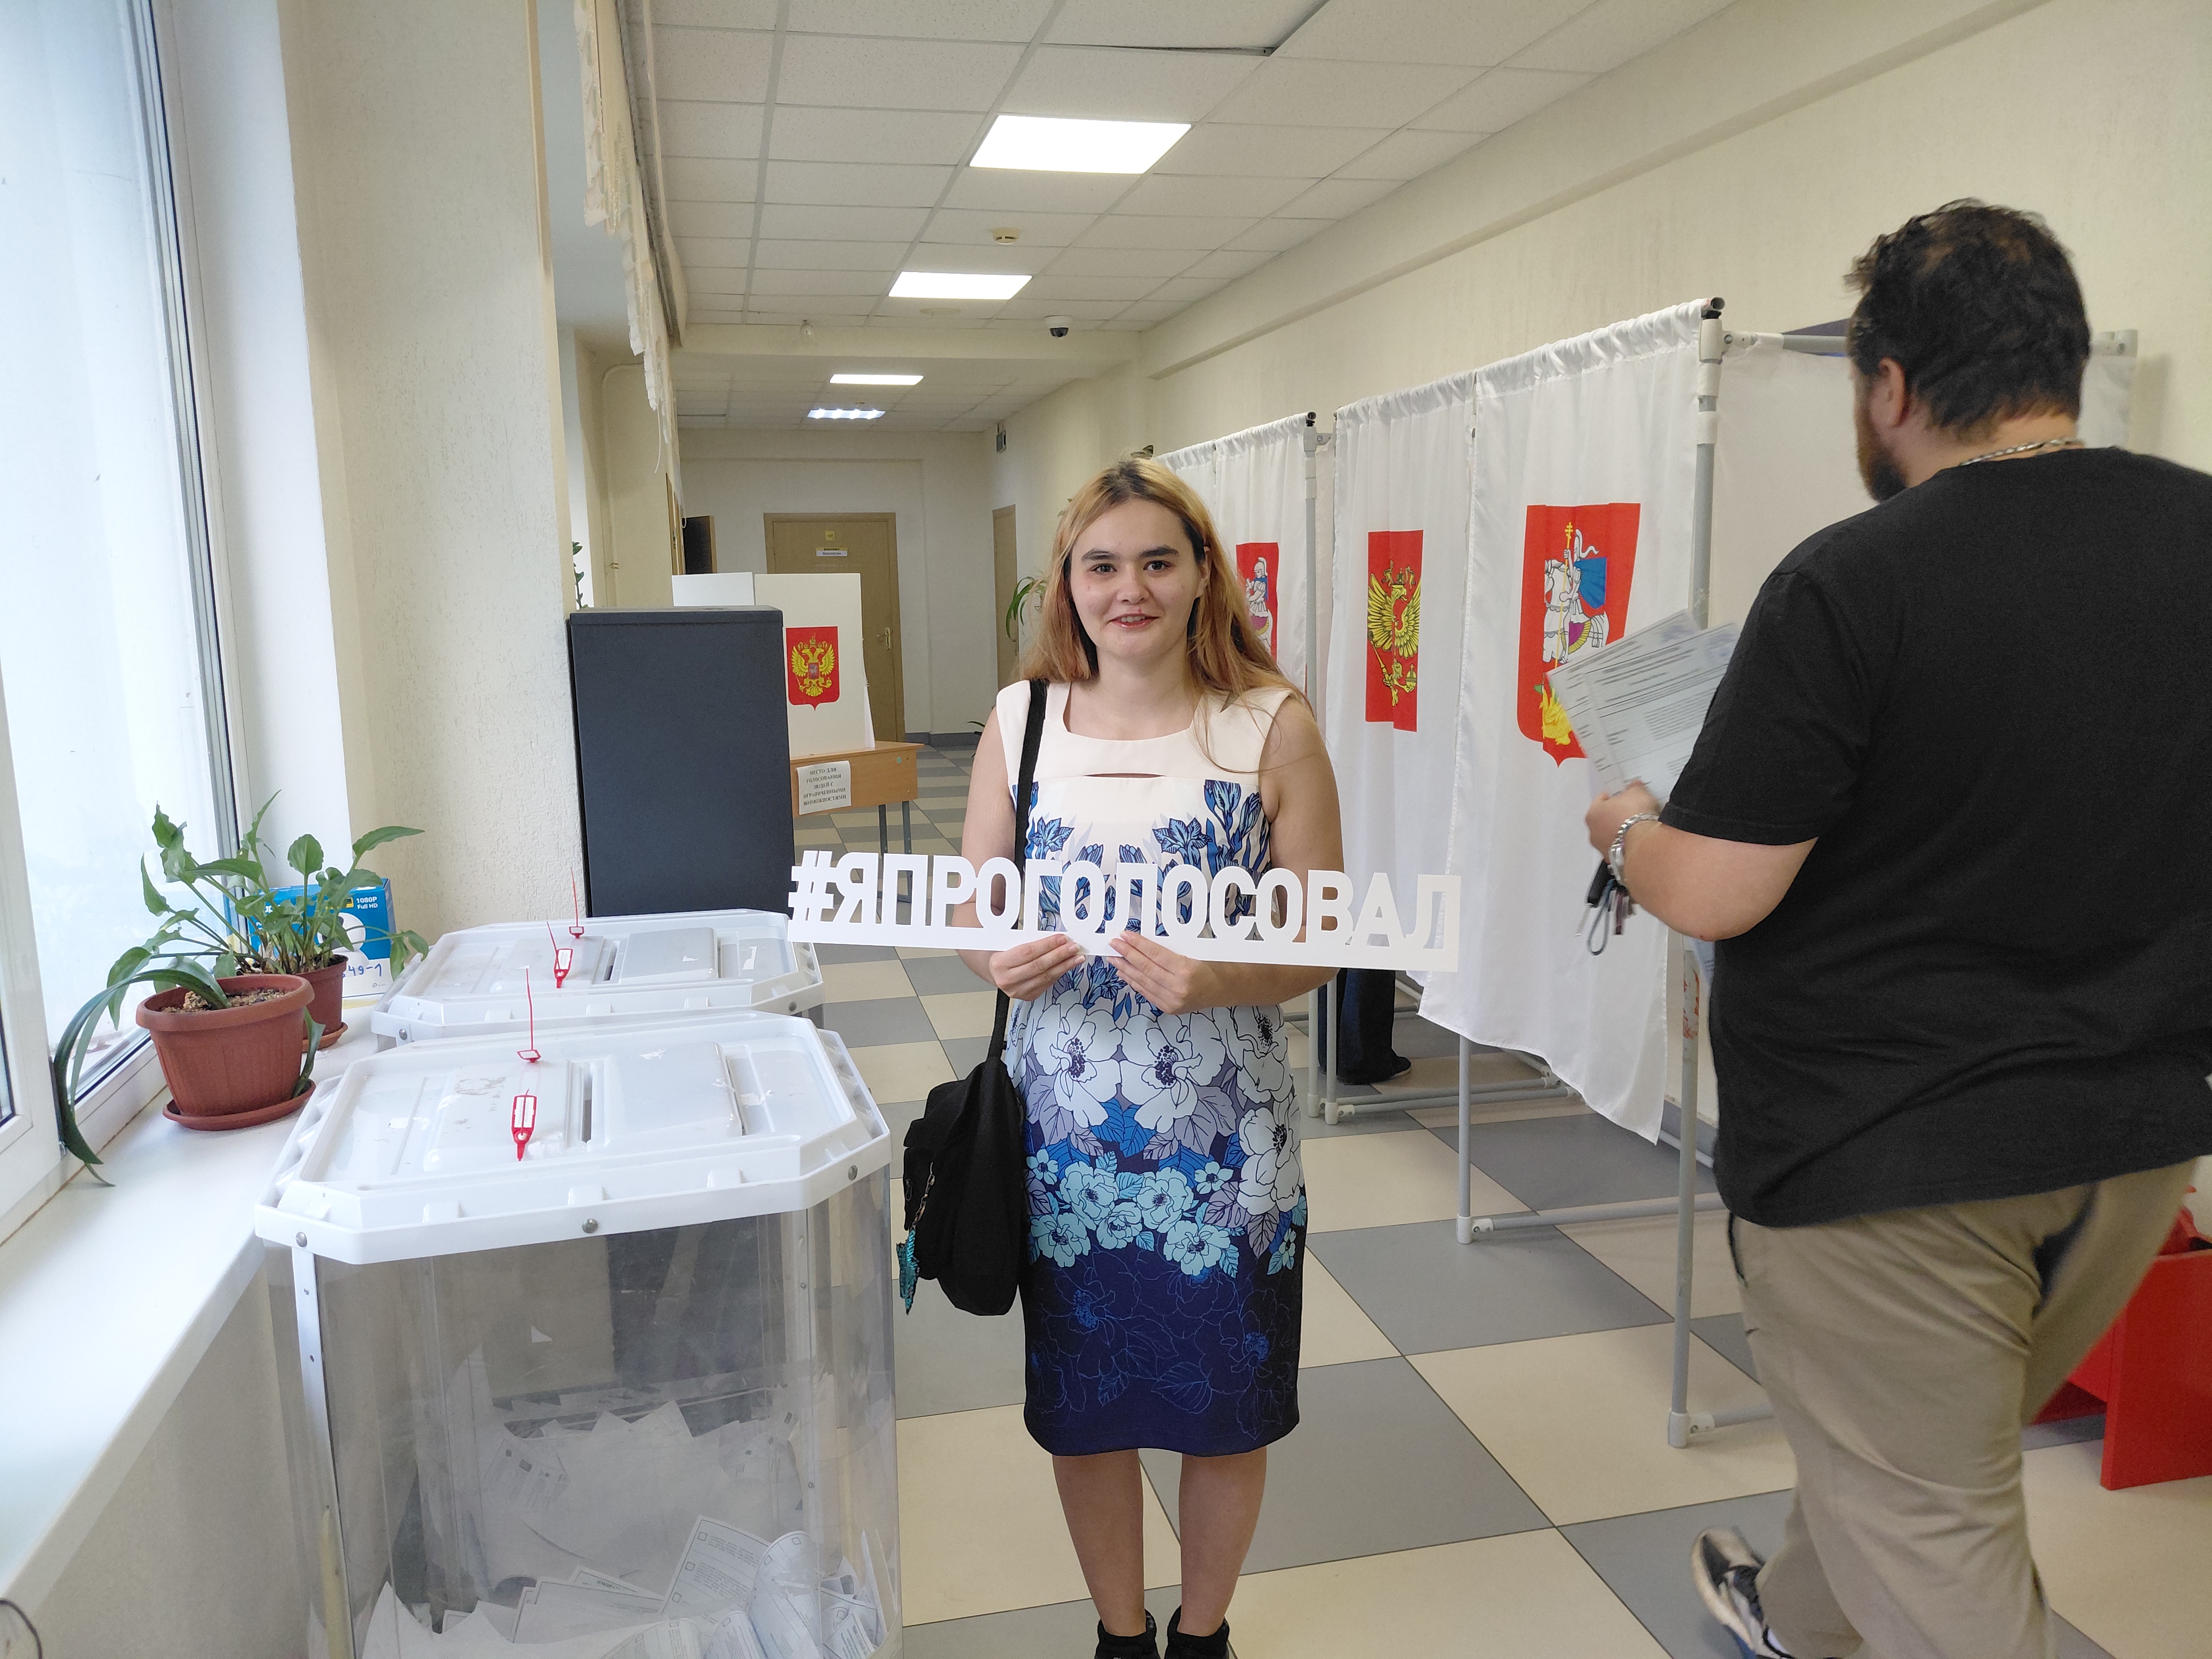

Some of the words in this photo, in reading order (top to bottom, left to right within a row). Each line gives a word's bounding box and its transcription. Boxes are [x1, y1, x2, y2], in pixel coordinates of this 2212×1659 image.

[806, 774, 841, 783] ГОЛОСОВАНИЯ
[813, 781, 829, 789] ЛЮДЕЙ
[803, 787, 846, 799] ОГРАНИЧЕННЫМИ
[803, 794, 846, 806] ВОЗМОЖНОСТЯМИ
[788, 850, 1462, 951] #ЯПРОГОЛОСОВАЛ
[342, 963, 382, 979] 49-1
